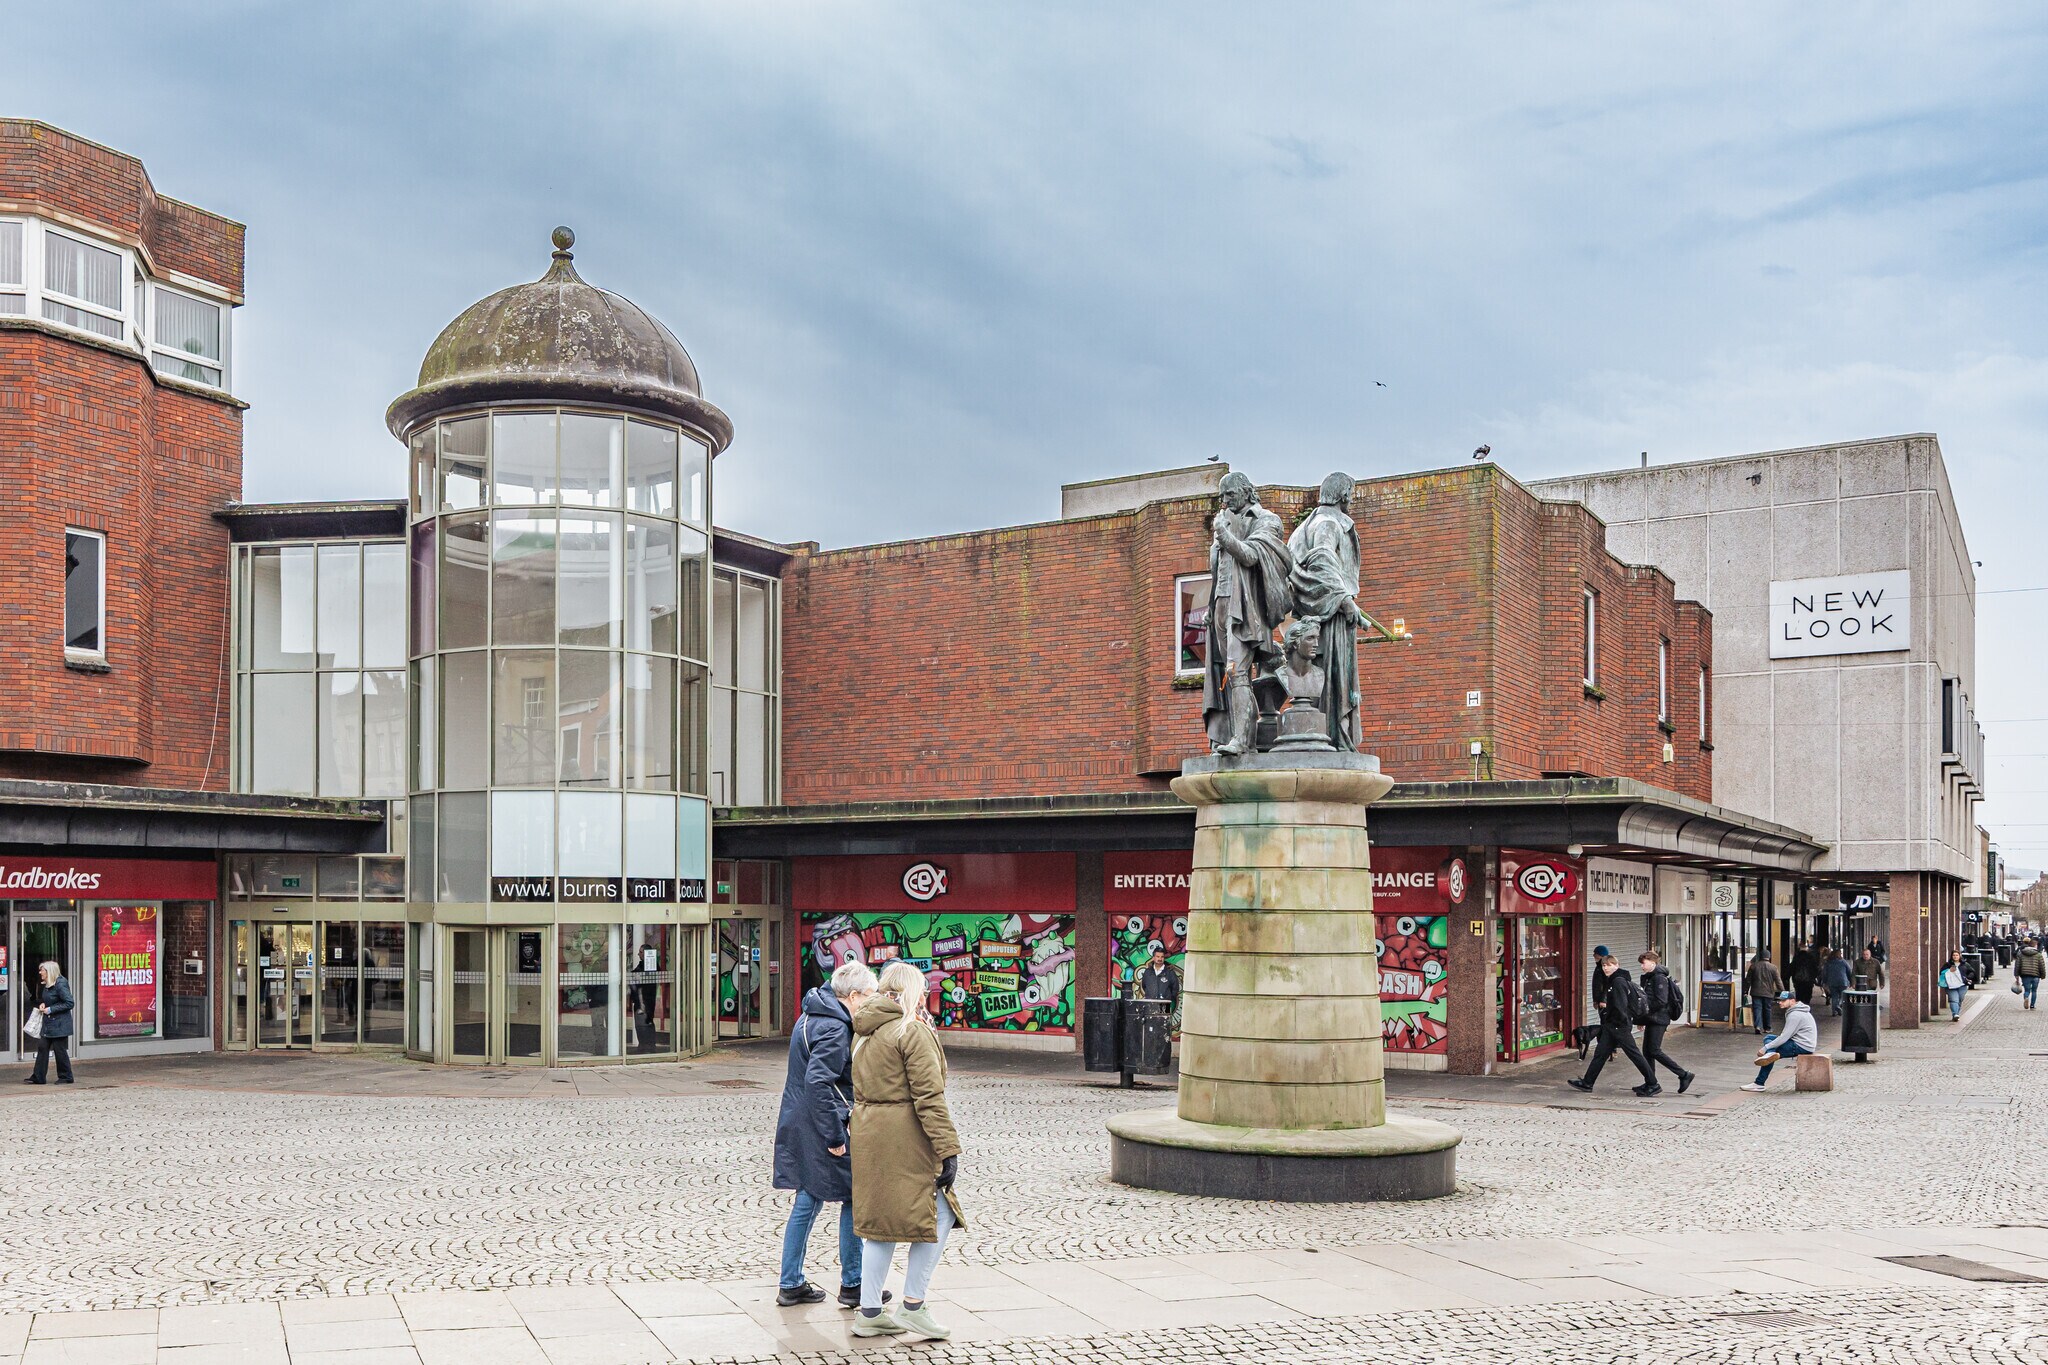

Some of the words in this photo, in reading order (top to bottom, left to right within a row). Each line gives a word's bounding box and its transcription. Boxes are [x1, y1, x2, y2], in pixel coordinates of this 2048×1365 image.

[1793, 588, 1884, 614] NEW
[1784, 614, 1893, 640] LOOK
[1468, 693, 1479, 705] H
[0, 866, 101, 890] Ladbrokes
[1114, 874, 1192, 888] ENTERTAI
[1371, 872, 1435, 887] HANGE
[563, 879, 617, 897] burns
[634, 880, 666, 898] mall
[1714, 885, 1733, 907] 3
[1850, 895, 1872, 908] JD
[1472, 922, 1482, 934] H
[861, 926, 885, 947] WE
[874, 947, 887, 960] BU
[934, 940, 961, 952] PHONES
[982, 944, 1018, 954] COMPUTERS
[101, 954, 123, 969] YOU
[125, 953, 151, 969] LOVE
[943, 956, 972, 970] MOVIES
[100, 969, 153, 986] REWARDS
[979, 974, 1015, 986] ELECTRONICS
[985, 994, 1017, 1012] CASH
